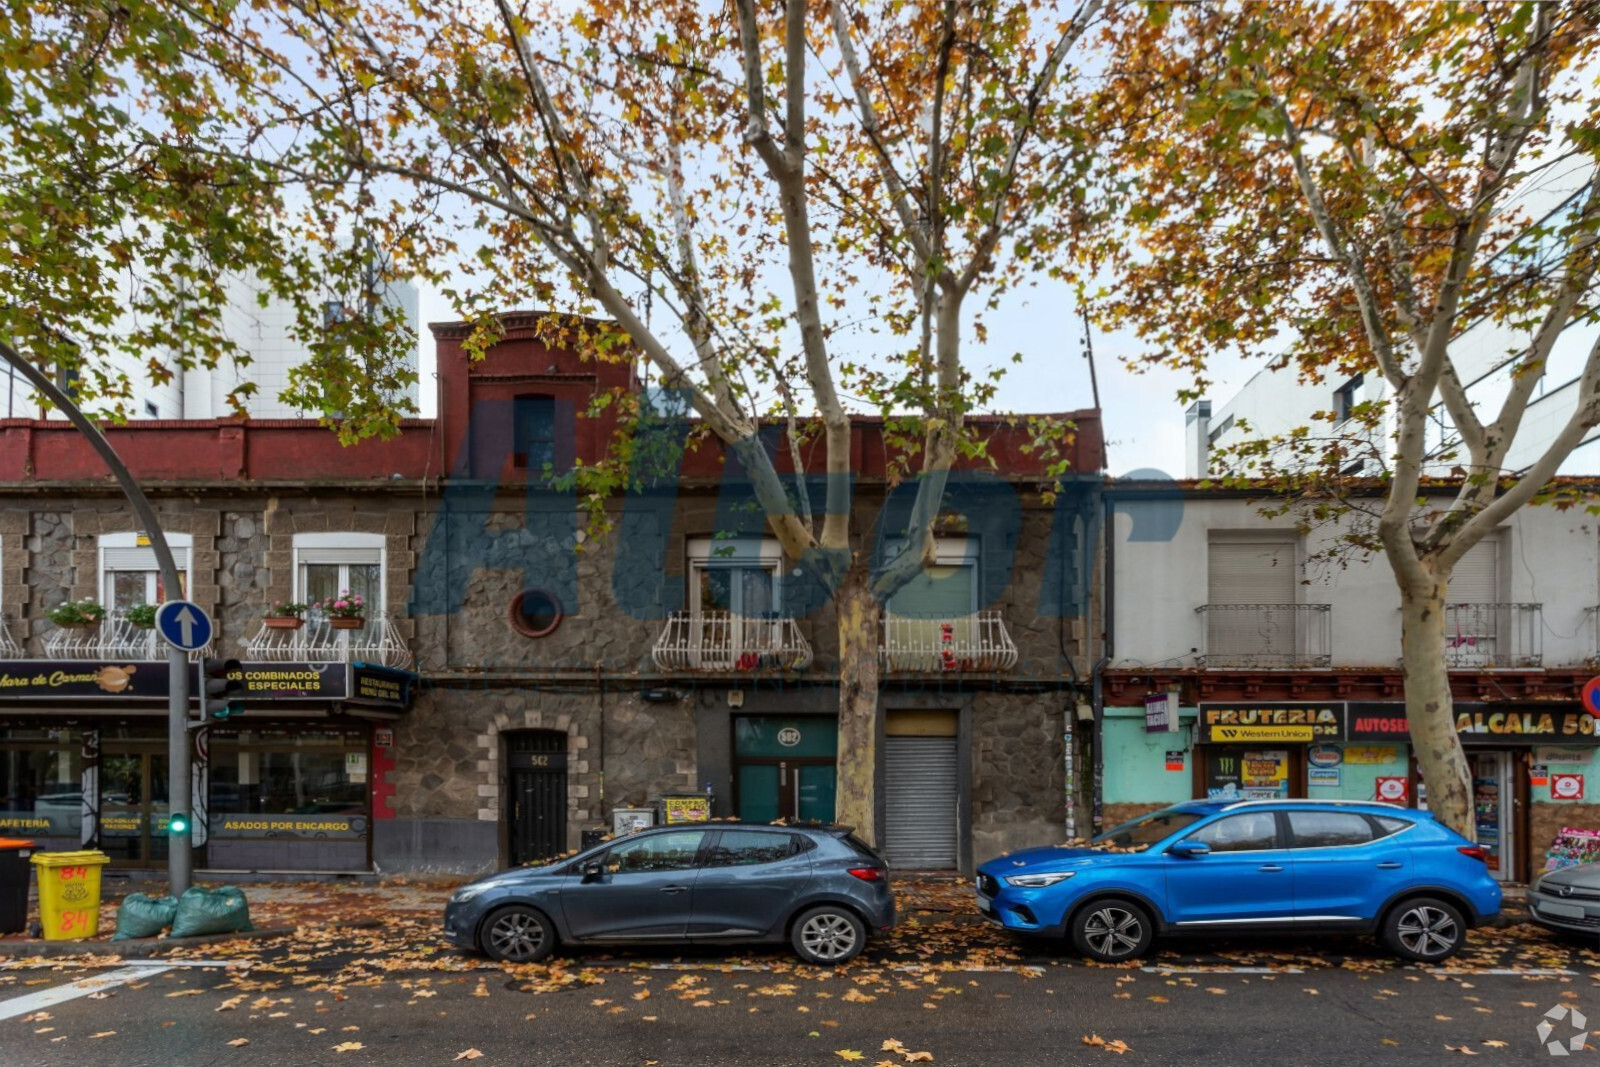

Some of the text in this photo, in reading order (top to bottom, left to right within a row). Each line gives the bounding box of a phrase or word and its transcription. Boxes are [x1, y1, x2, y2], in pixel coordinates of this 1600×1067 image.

[31, 674, 47, 686] de
[49, 671, 98, 686] Carmen
[245, 671, 320, 680] COMBINADOS
[248, 681, 320, 690] ESPECIALES
[1207, 709, 1337, 724] FRUTERIA
[1456, 713, 1555, 734] ALCALA
[1240, 729, 1310, 738] Western Union
[224, 821, 349, 831] ASADOS POR ENCARGO
[60, 866, 88, 880] 84
[60, 910, 88, 931] 84
